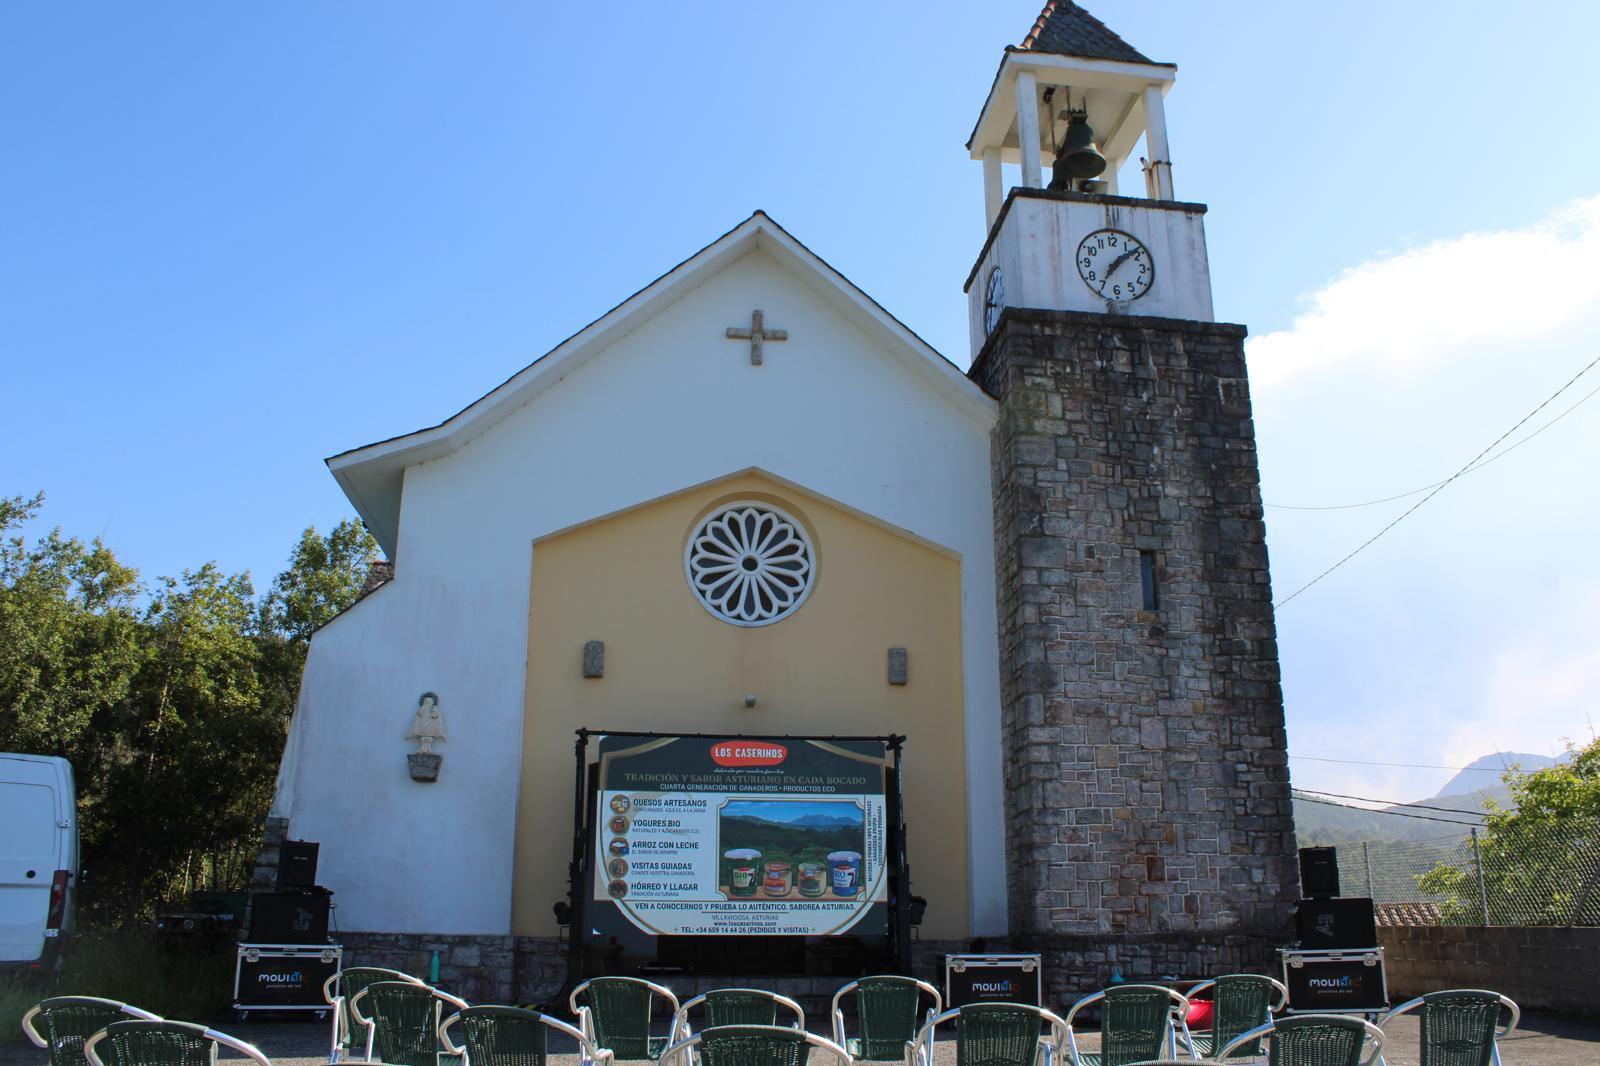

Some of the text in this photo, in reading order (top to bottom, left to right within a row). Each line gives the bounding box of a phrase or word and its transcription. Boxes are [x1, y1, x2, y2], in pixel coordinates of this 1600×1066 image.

[1097, 239, 1104, 249] 11
[1107, 236, 1117, 247] 12
[1124, 241, 1127, 252] 1
[1087, 246, 1097, 256] 10
[1134, 251, 1140, 261] 2
[1084, 258, 1091, 268] 9
[1139, 264, 1146, 274] 3
[1088, 271, 1096, 280] 8
[1099, 280, 1106, 290] 7
[1113, 285, 1120, 295] 6
[1127, 282, 1135, 292] 5
[715, 748, 783, 758] LOS CASERINOS
[624, 771, 866, 785] TRADICIÓN Y SABOR ASTURIANO EN CADA BOCADO
[631, 882, 661, 890] HÓRREO
